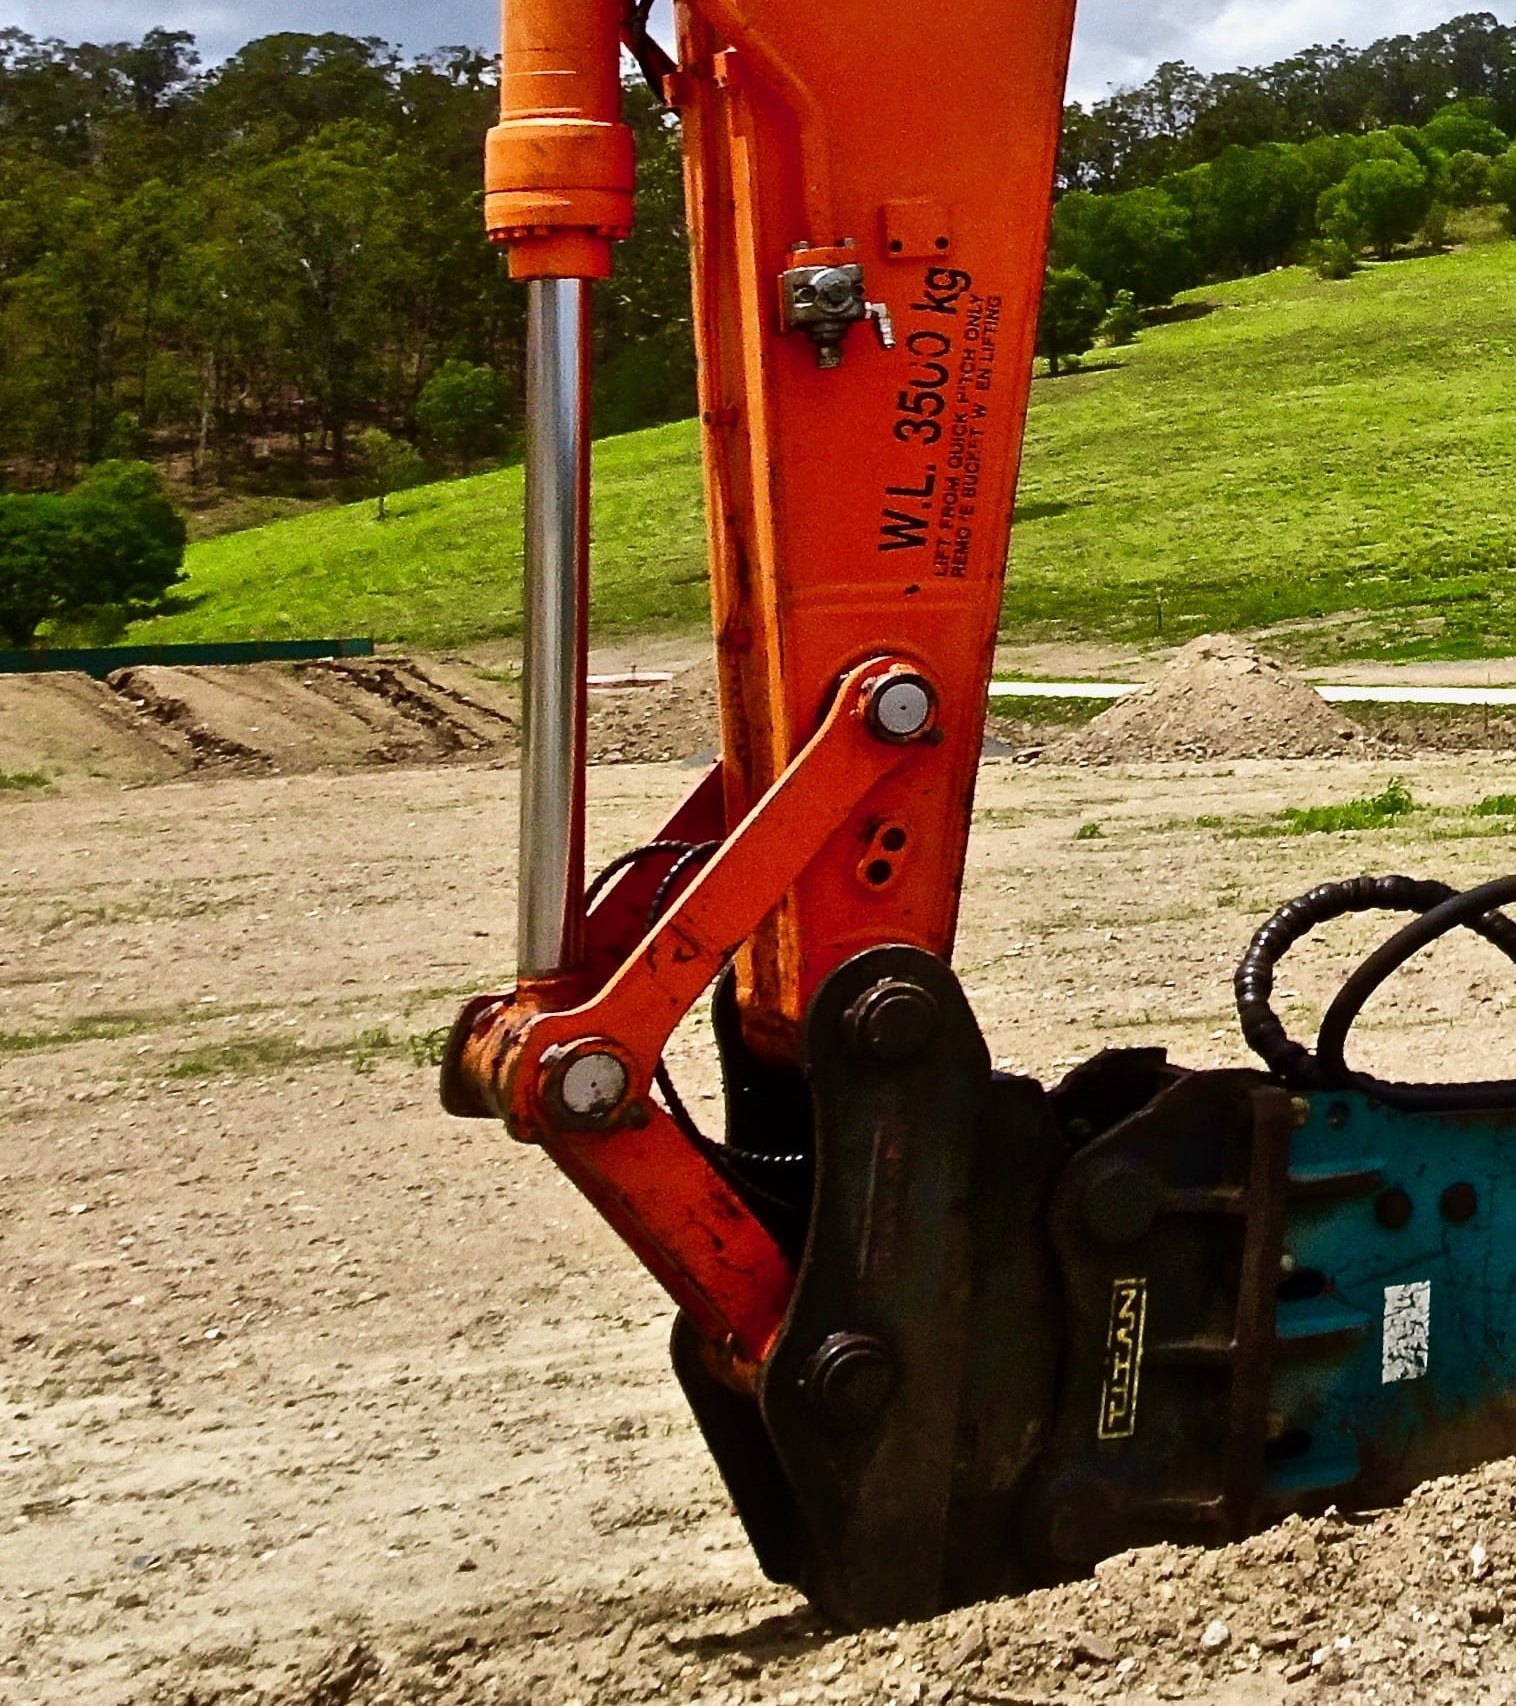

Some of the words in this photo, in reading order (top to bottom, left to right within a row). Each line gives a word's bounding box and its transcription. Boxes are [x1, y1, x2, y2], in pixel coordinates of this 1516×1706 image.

[911, 266, 973, 315] kg
[963, 294, 985, 342] ONLY
[979, 295, 1002, 363] LIFTING
[894, 331, 952, 445] 3500
[970, 368, 992, 420] WEN
[947, 412, 968, 470] QUICK
[878, 462, 937, 552] W.L.
[939, 477, 959, 529] FROM
[933, 538, 952, 578] LIFT
[951, 506, 973, 577] REMOE
